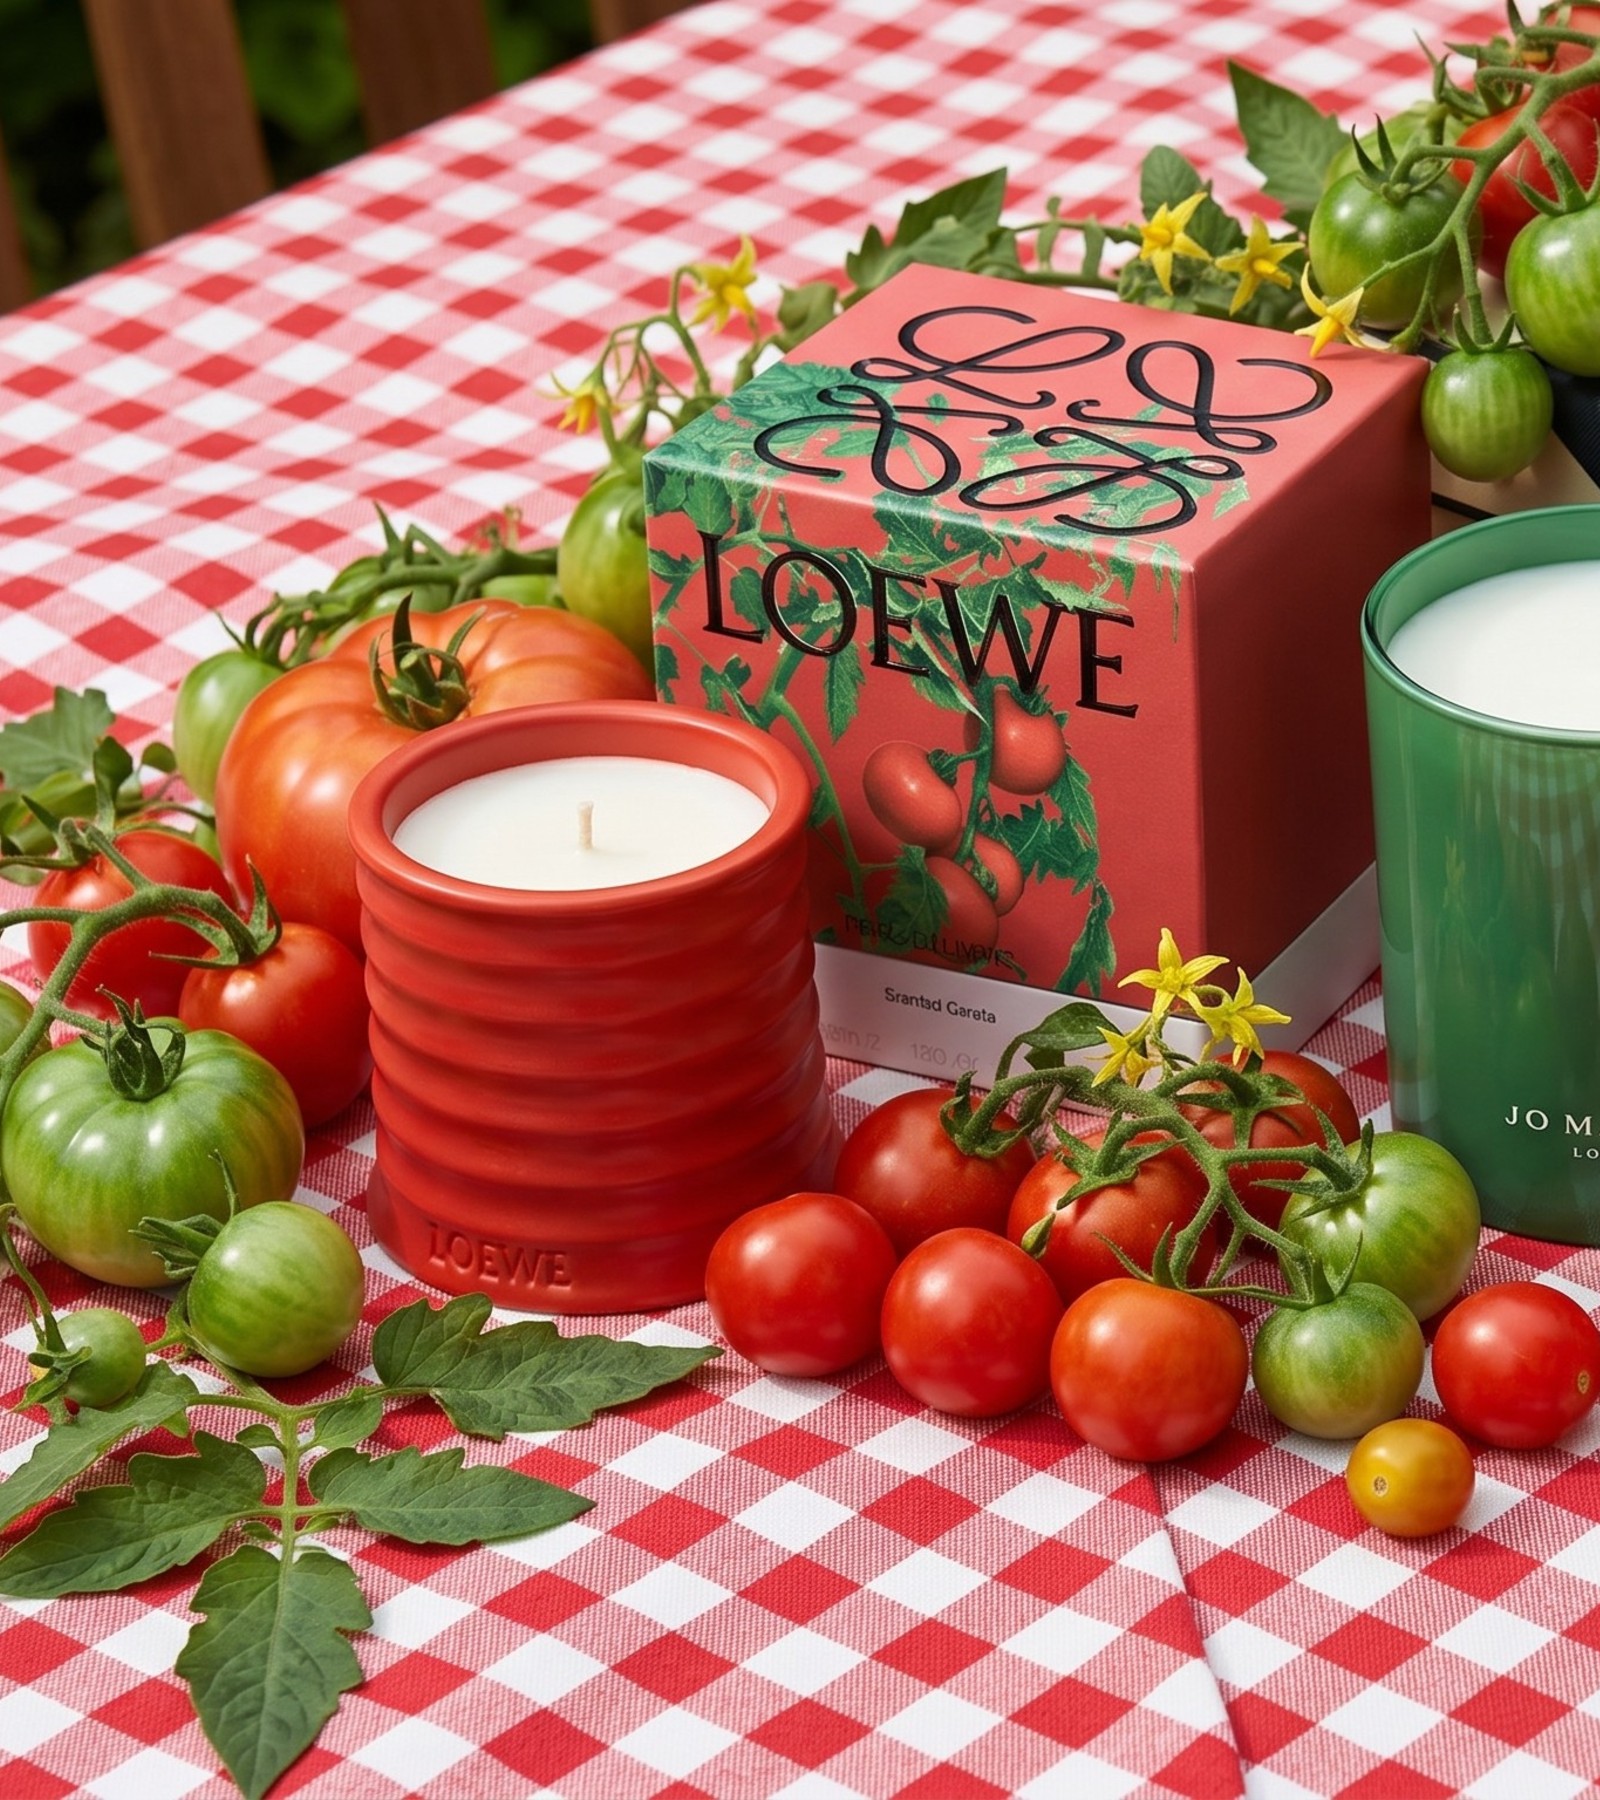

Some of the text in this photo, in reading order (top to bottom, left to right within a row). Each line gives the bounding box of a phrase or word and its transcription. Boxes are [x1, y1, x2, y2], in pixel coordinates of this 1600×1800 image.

[697, 530, 1139, 717] LOEWE
[1504, 1104, 1550, 1131] JO
[427, 1221, 574, 1291] LOEWE
